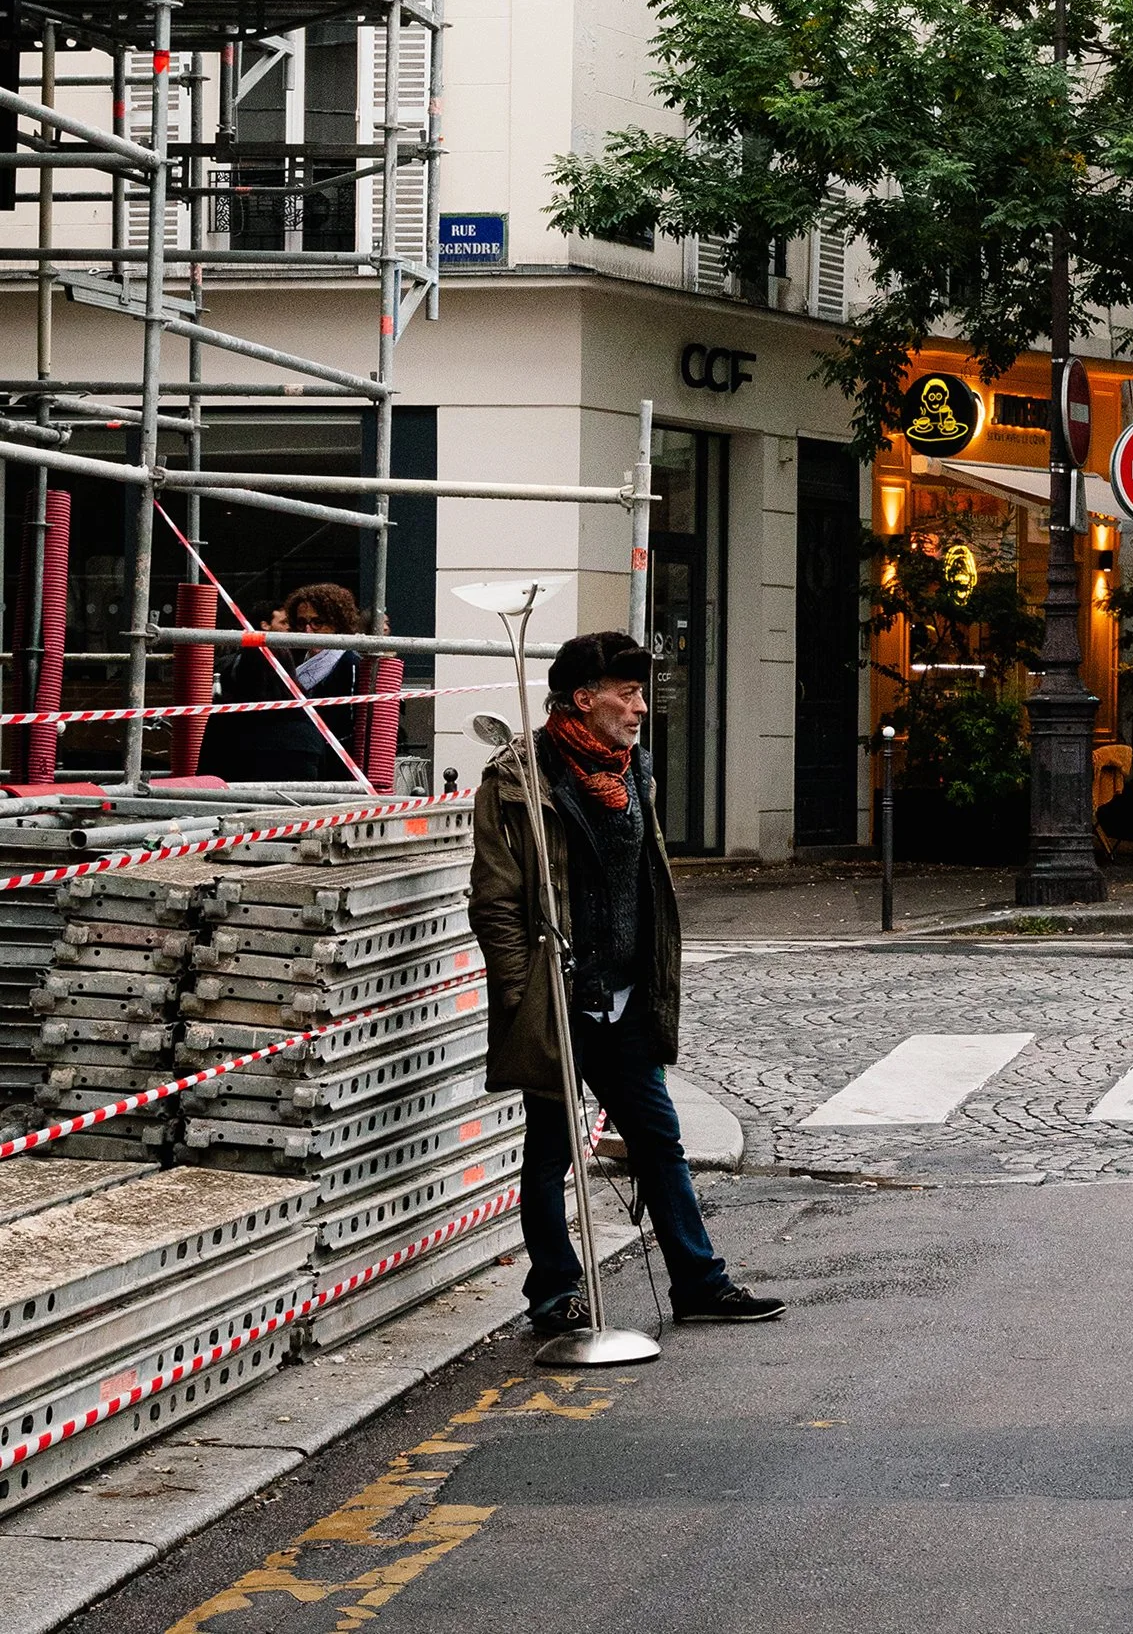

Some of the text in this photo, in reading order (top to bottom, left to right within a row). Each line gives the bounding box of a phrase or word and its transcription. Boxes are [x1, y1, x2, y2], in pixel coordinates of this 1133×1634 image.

[451, 224, 476, 237] RUE
[439, 242, 500, 255] EGENDRE
[681, 343, 757, 394] CCF
[657, 672, 672, 682] CCF
